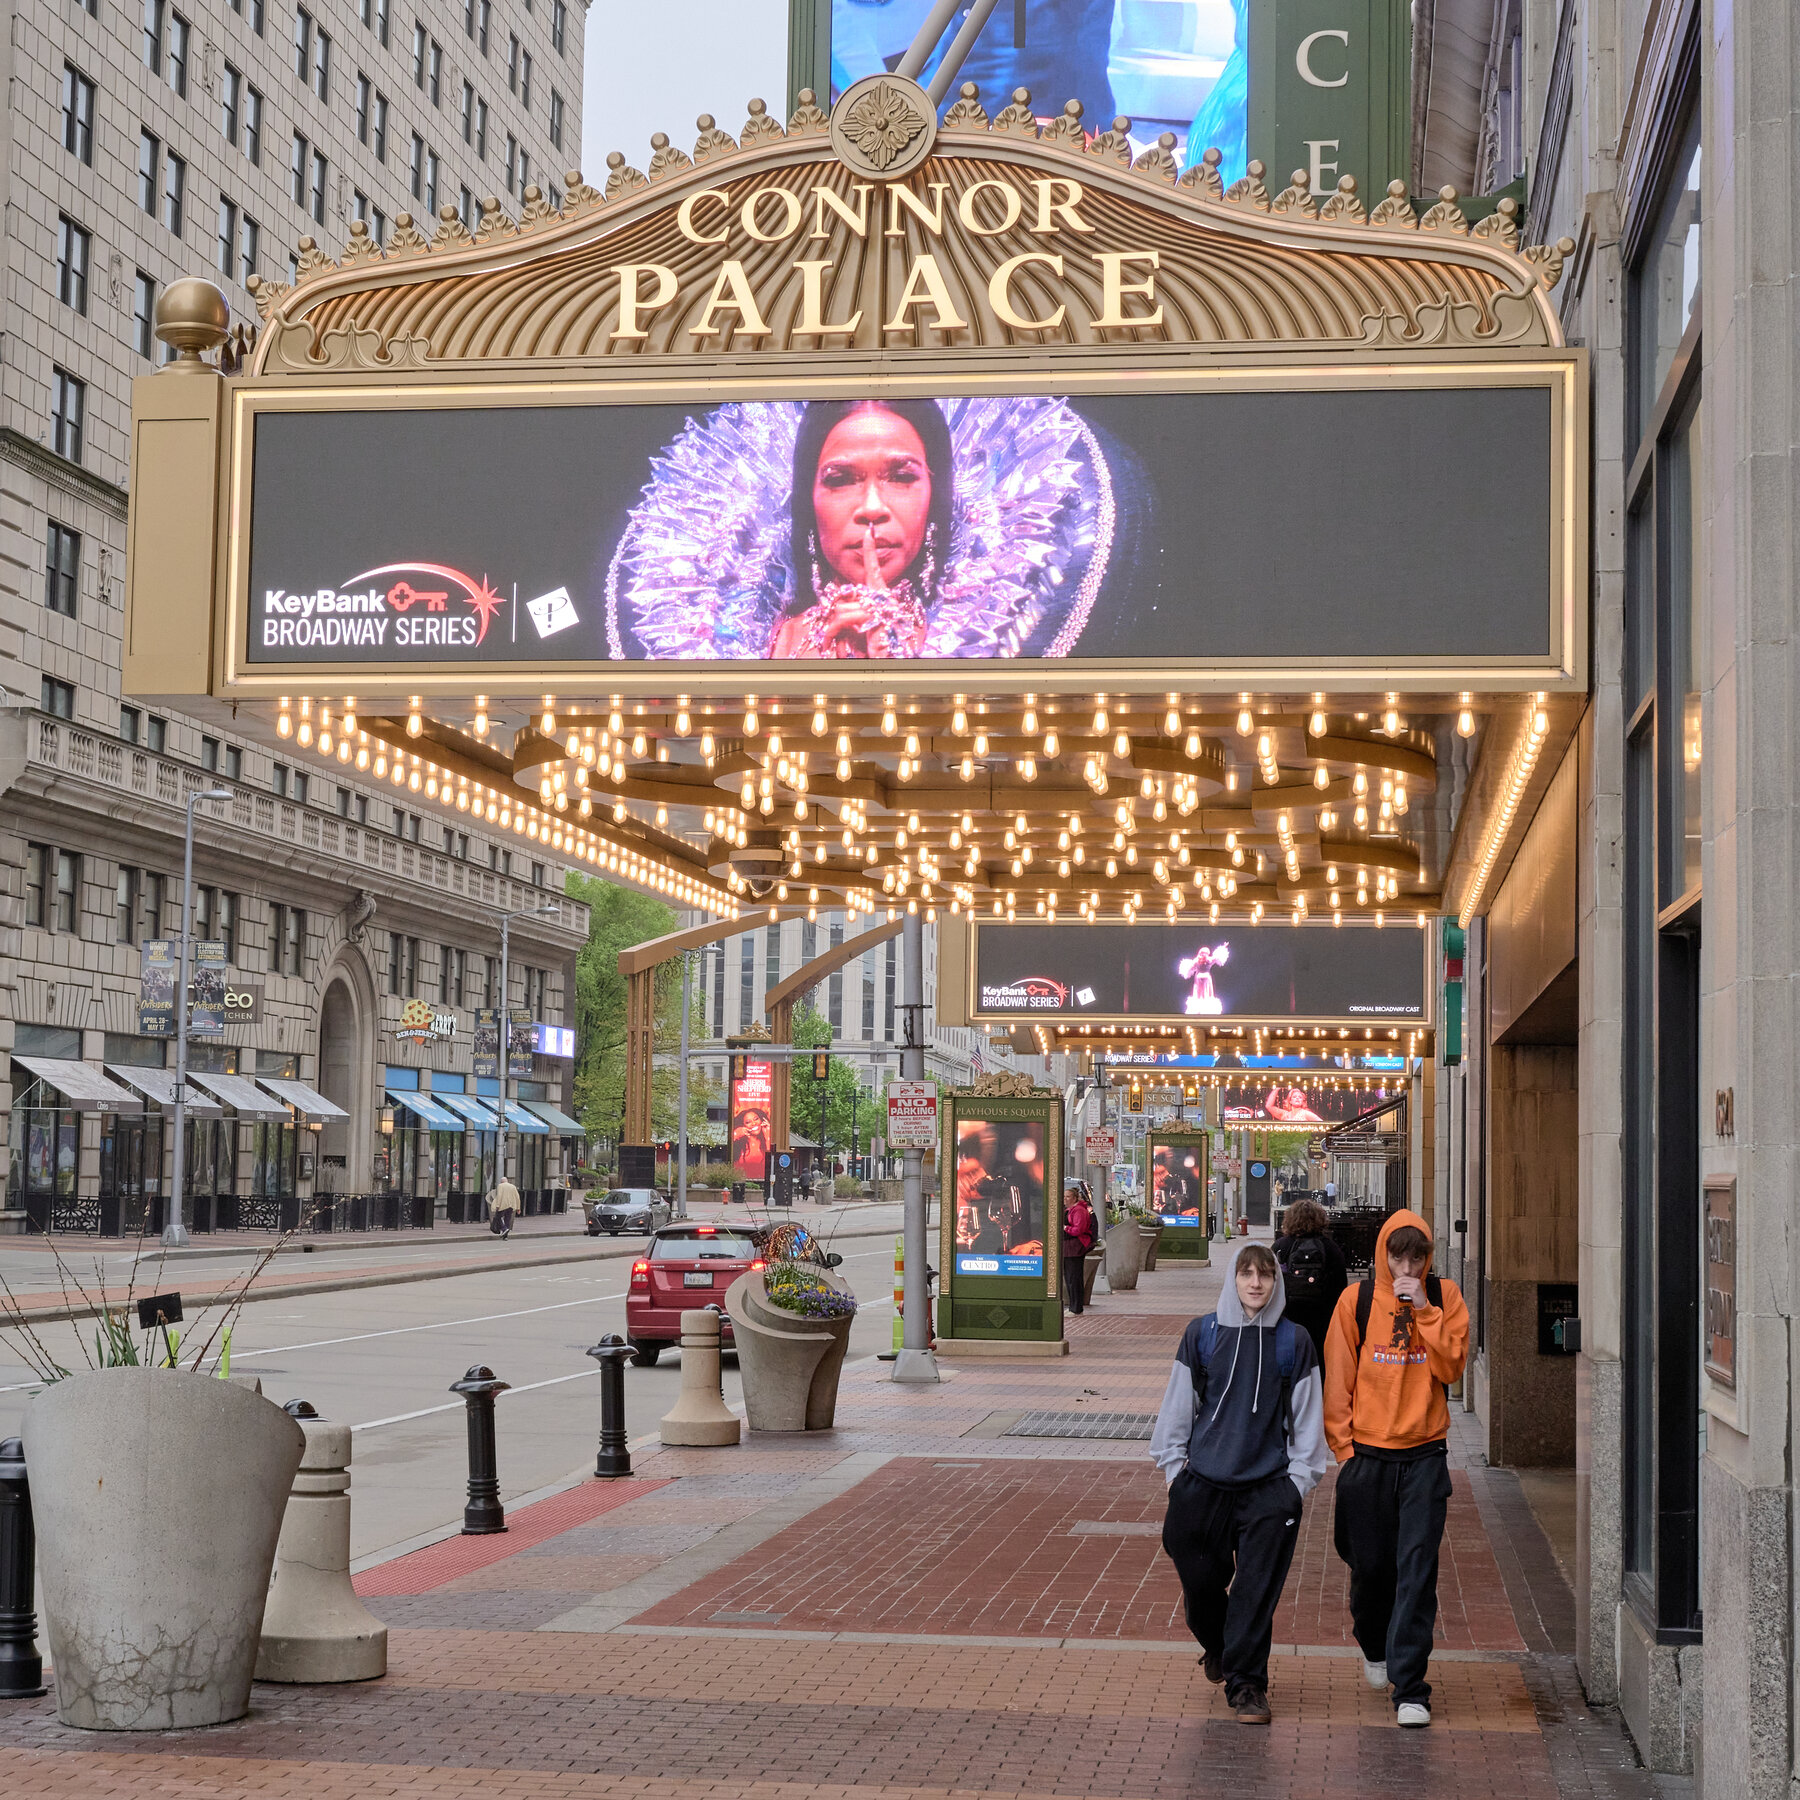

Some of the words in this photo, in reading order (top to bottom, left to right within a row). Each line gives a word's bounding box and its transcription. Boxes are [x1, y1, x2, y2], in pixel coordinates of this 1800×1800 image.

[677, 178, 1096, 246] CONNOR
[609, 251, 1165, 340] PALACE
[265, 589, 386, 618] KeyBank
[264, 617, 388, 646] BROADWAY
[395, 616, 477, 645] SERIES
[983, 986, 1028, 997] KeyBank
[983, 996, 1028, 1008] BROADWAY
[1030, 997, 1060, 1008] SERIES
[1105, 1054, 1133, 1063] ROADWAY
[1133, 1055, 1155, 1063] SERIES
[897, 1098, 928, 1107] NO
[890, 1107, 934, 1116] PARKING
[956, 1107, 1008, 1116] PLAYHOUSE
[1011, 1108, 1047, 1118] SQUARE
[963, 1261, 996, 1270] CENTRO
